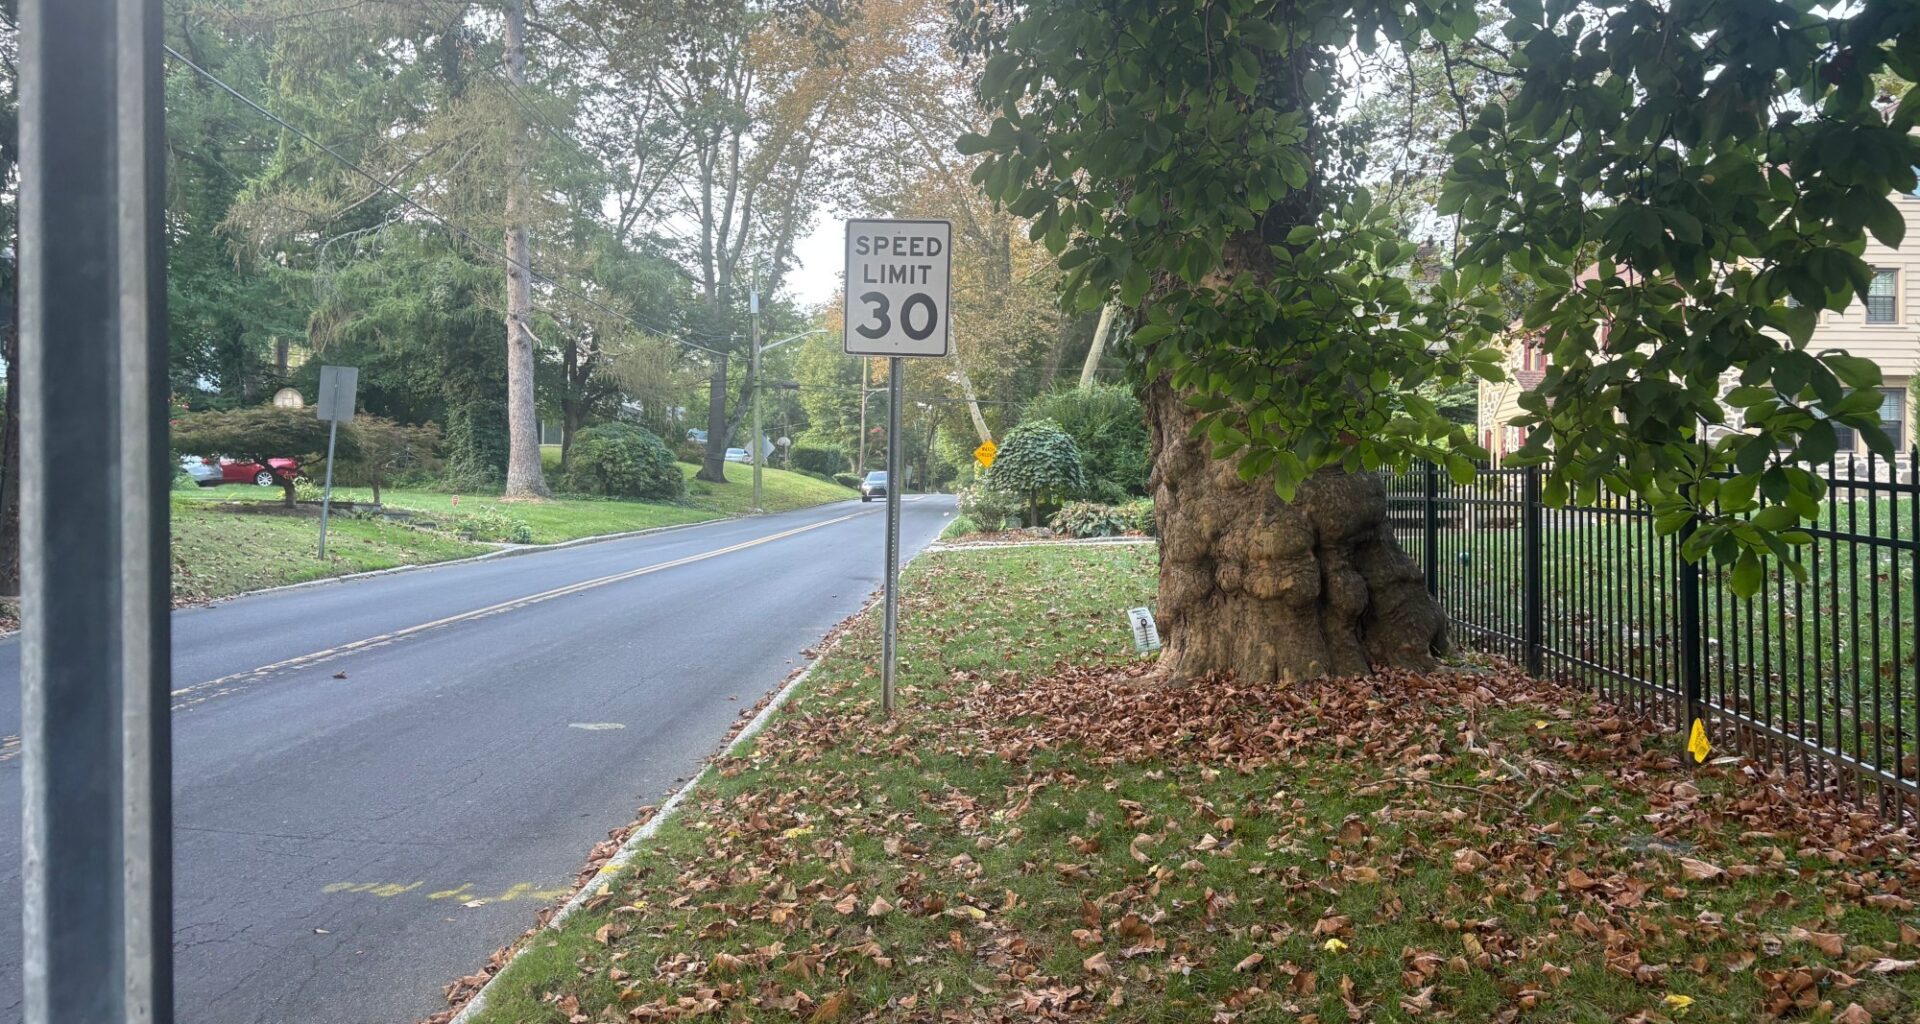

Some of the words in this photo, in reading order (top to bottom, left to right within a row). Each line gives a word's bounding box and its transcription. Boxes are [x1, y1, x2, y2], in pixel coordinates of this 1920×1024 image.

[855, 235, 942, 257] SPEED
[863, 264, 932, 285] LIMIT
[855, 291, 938, 341] 30
